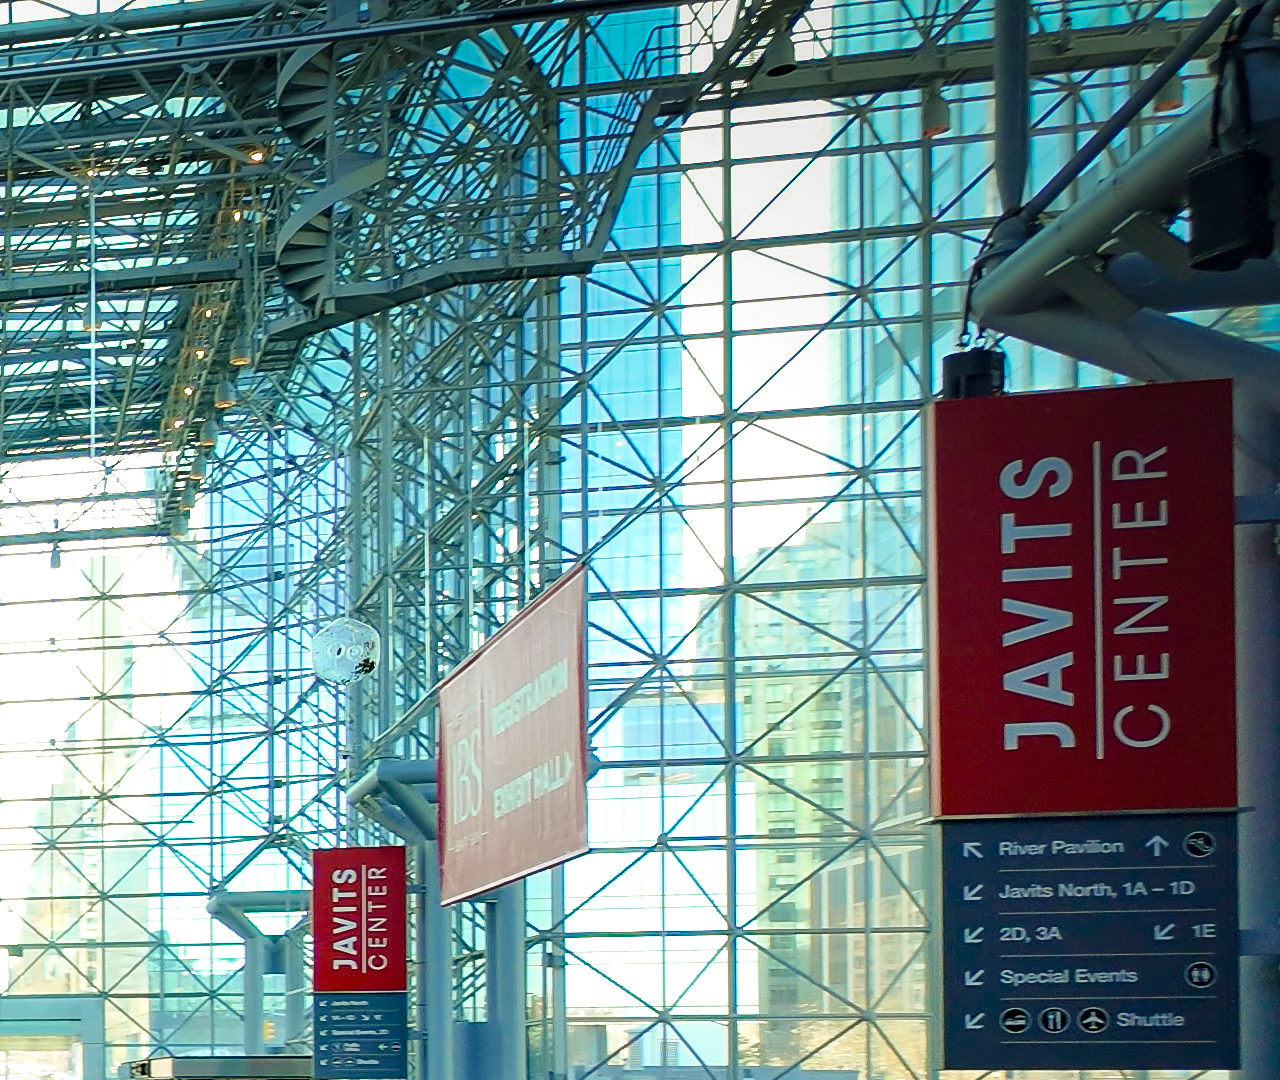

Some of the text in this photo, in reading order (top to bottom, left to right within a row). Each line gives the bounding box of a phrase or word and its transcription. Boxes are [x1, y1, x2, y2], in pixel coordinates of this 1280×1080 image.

[999, 454, 1076, 751] JAVITS
[1111, 445, 1171, 749] CENTER
[451, 728, 483, 824] IBS
[999, 840, 1125, 856] River Pavilion
[999, 883, 1054, 899] Javits
[1058, 882, 1117, 898] North,
[1122, 881, 1148, 896] 1A
[1170, 880, 1196, 895] 1D
[331, 868, 358, 970] JAVITS
[367, 867, 388, 971] CENTER
[999, 926, 1063, 943] 2D, 3A
[1191, 923, 1217, 938] 1E
[1000, 968, 1139, 987] Special Events
[1116, 1012, 1185, 1027] Shuttle
